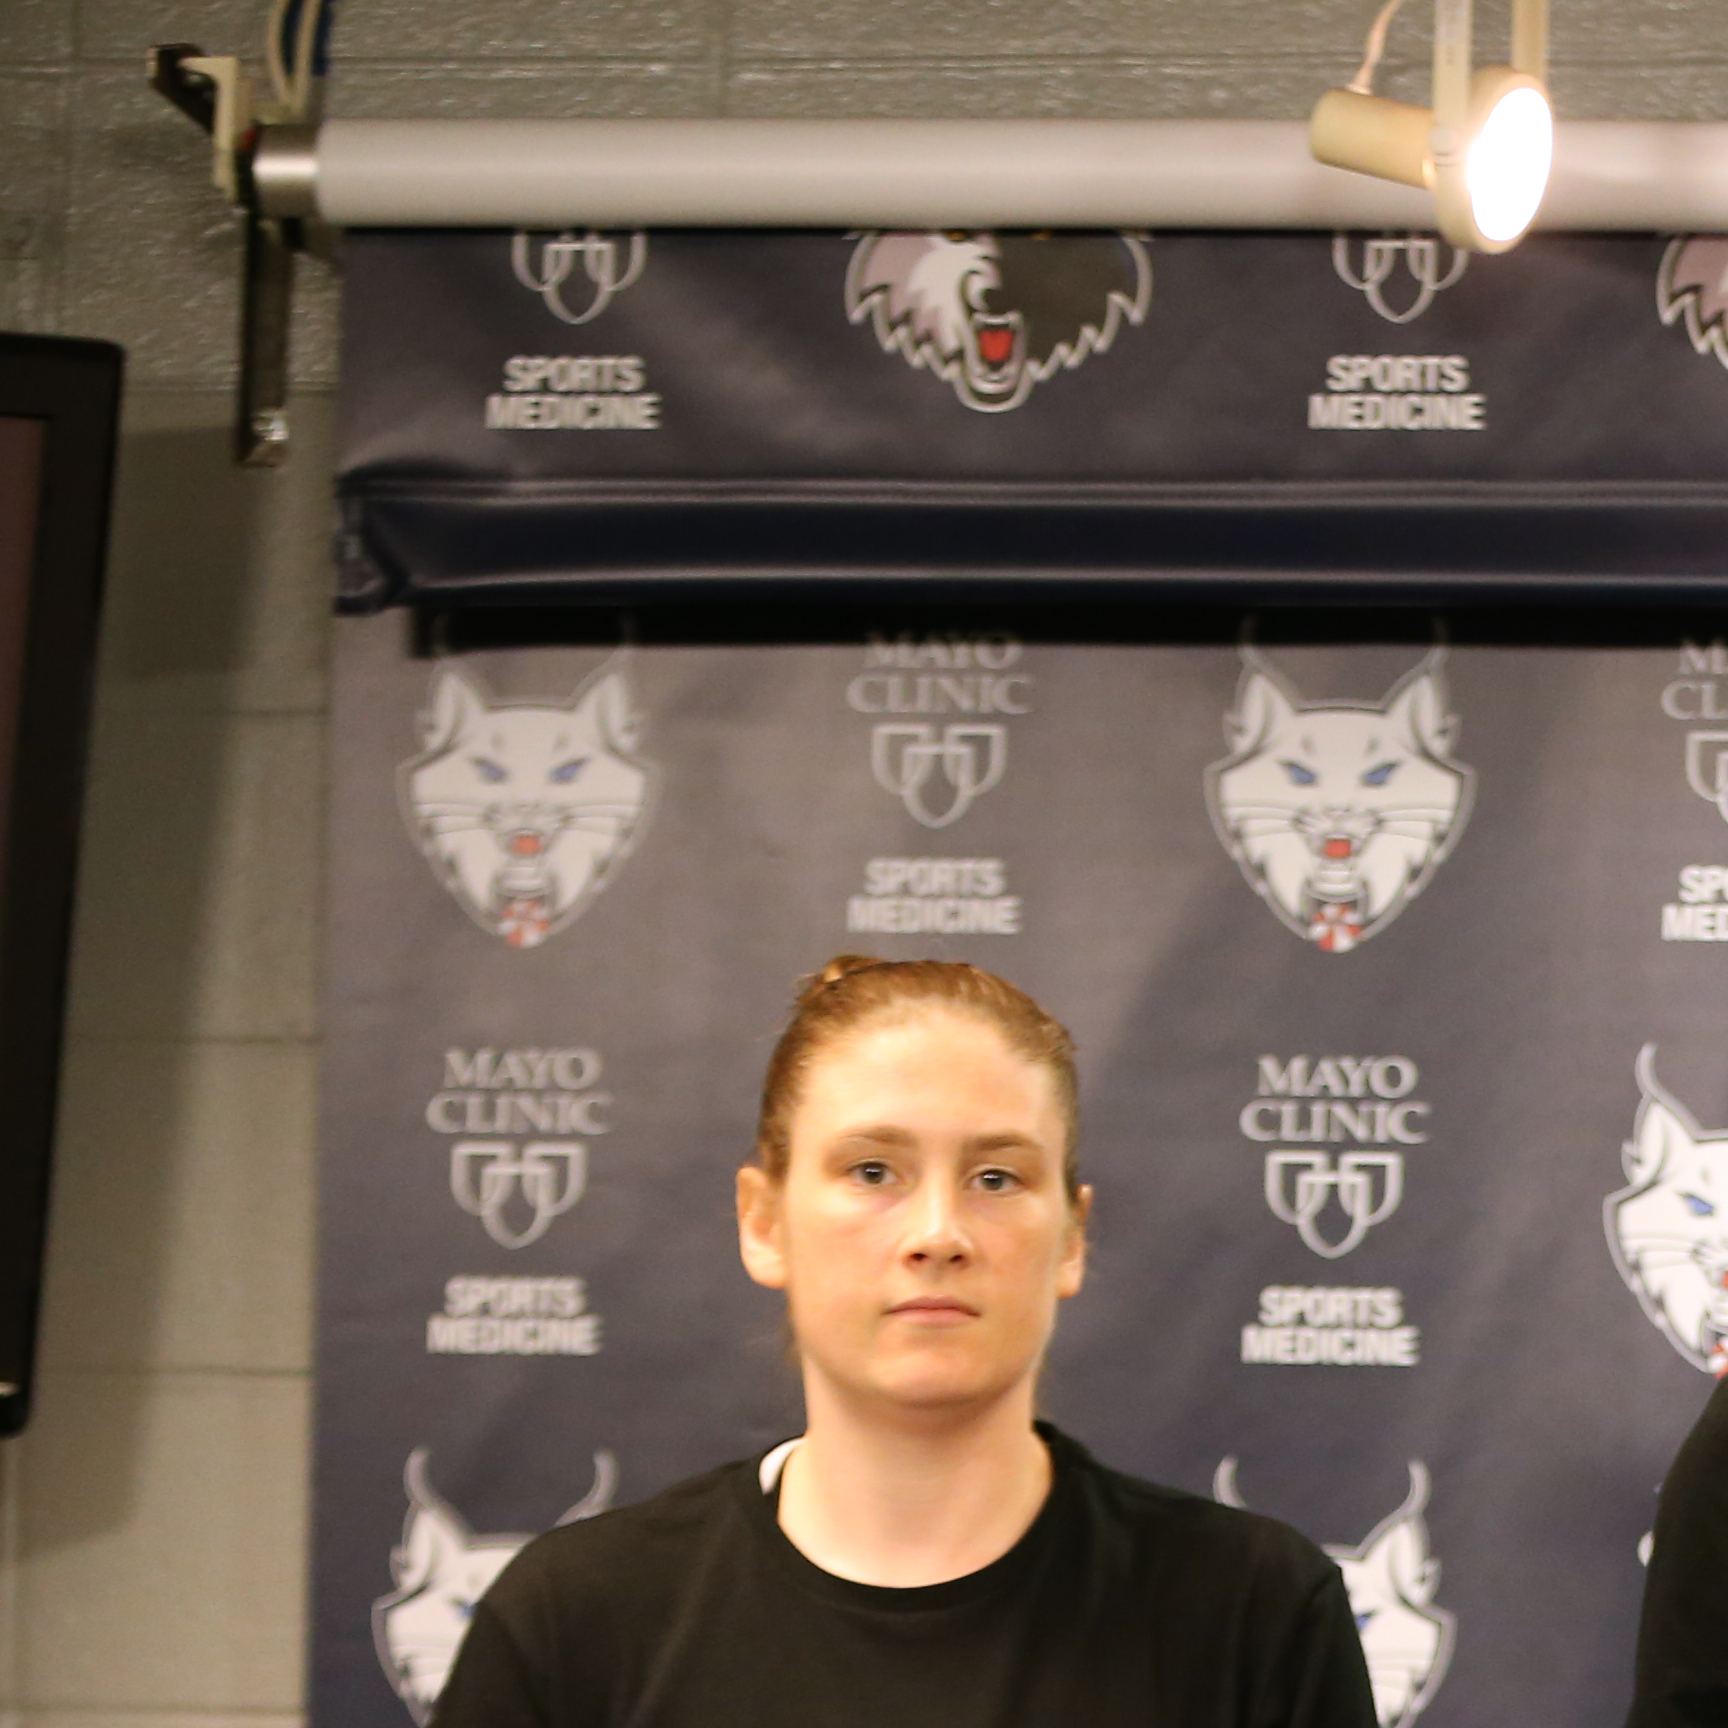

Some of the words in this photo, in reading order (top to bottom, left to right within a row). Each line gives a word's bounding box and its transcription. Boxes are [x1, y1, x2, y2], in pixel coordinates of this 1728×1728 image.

[504, 355, 647, 393] SPORTS
[1326, 354, 1471, 393] SPORTS
[485, 393, 661, 430] MEDICINE
[1308, 394, 1487, 431] MEDICINE
[846, 673, 1034, 714] CLINIC
[863, 857, 1006, 896] SPORTS
[846, 896, 1021, 934] MEDICINE
[443, 1047, 603, 1090] MAYO
[1257, 1055, 1418, 1098] MAYO
[427, 1091, 611, 1135] CLINIC
[1239, 1099, 1431, 1145] CLINIC
[444, 1276, 586, 1318] SPORTS
[1259, 1286, 1403, 1328] SPORTS
[426, 1316, 605, 1355] MEDICINE
[1241, 1325, 1421, 1367] MEDICINE
